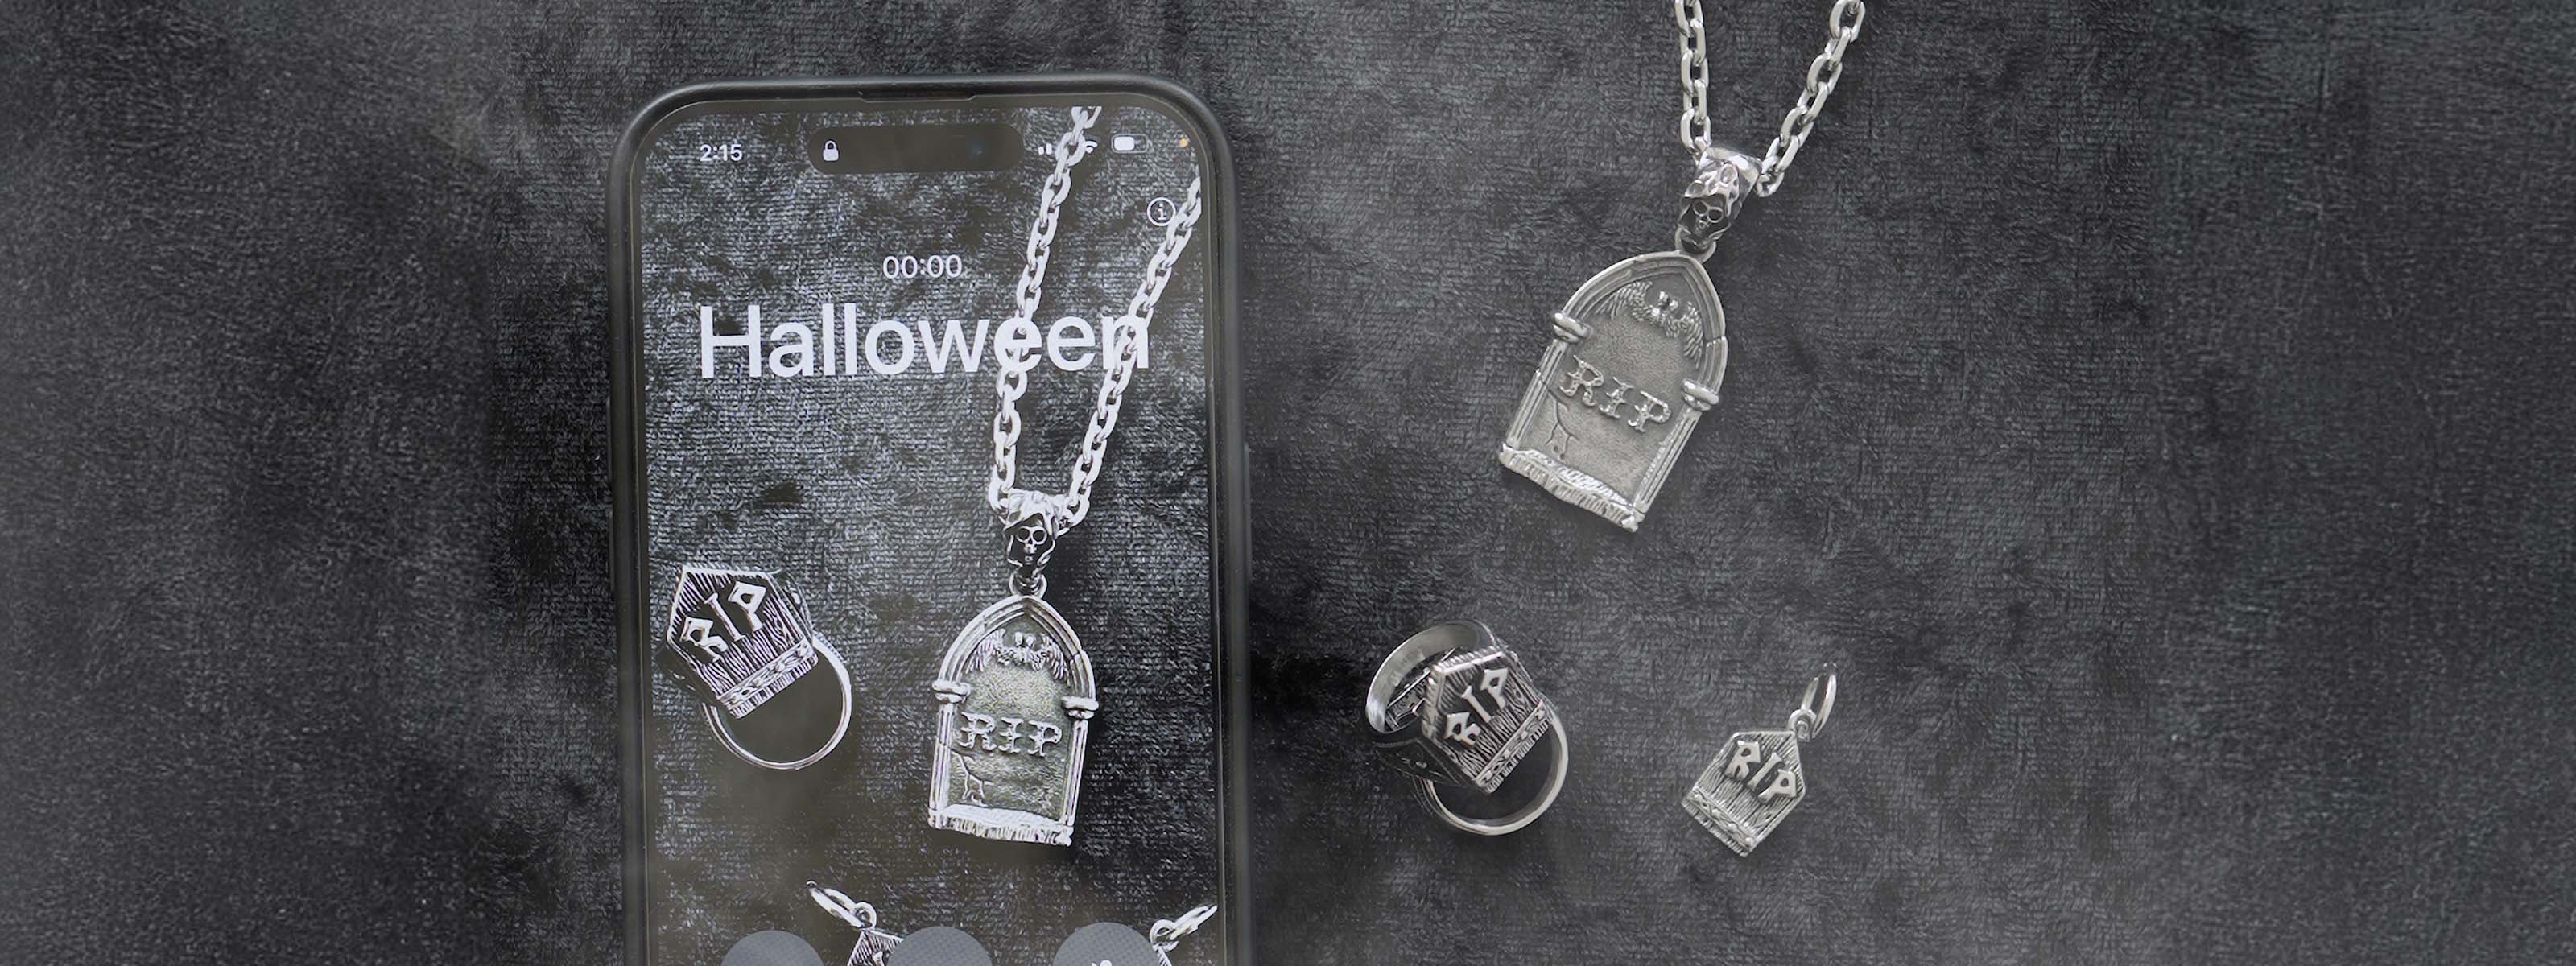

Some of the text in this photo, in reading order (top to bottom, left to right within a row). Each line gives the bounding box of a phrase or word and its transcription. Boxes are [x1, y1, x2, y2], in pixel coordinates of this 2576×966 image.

[700, 144, 743, 163] 2:15
[882, 254, 963, 278] 00:00
[699, 302, 1150, 378] Halloween
[1559, 356, 1670, 433] RIP
[680, 580, 766, 663] RIP
[959, 712, 1063, 758] RIP
[1444, 667, 1509, 747] RIP
[1725, 739, 1798, 801] RIP
